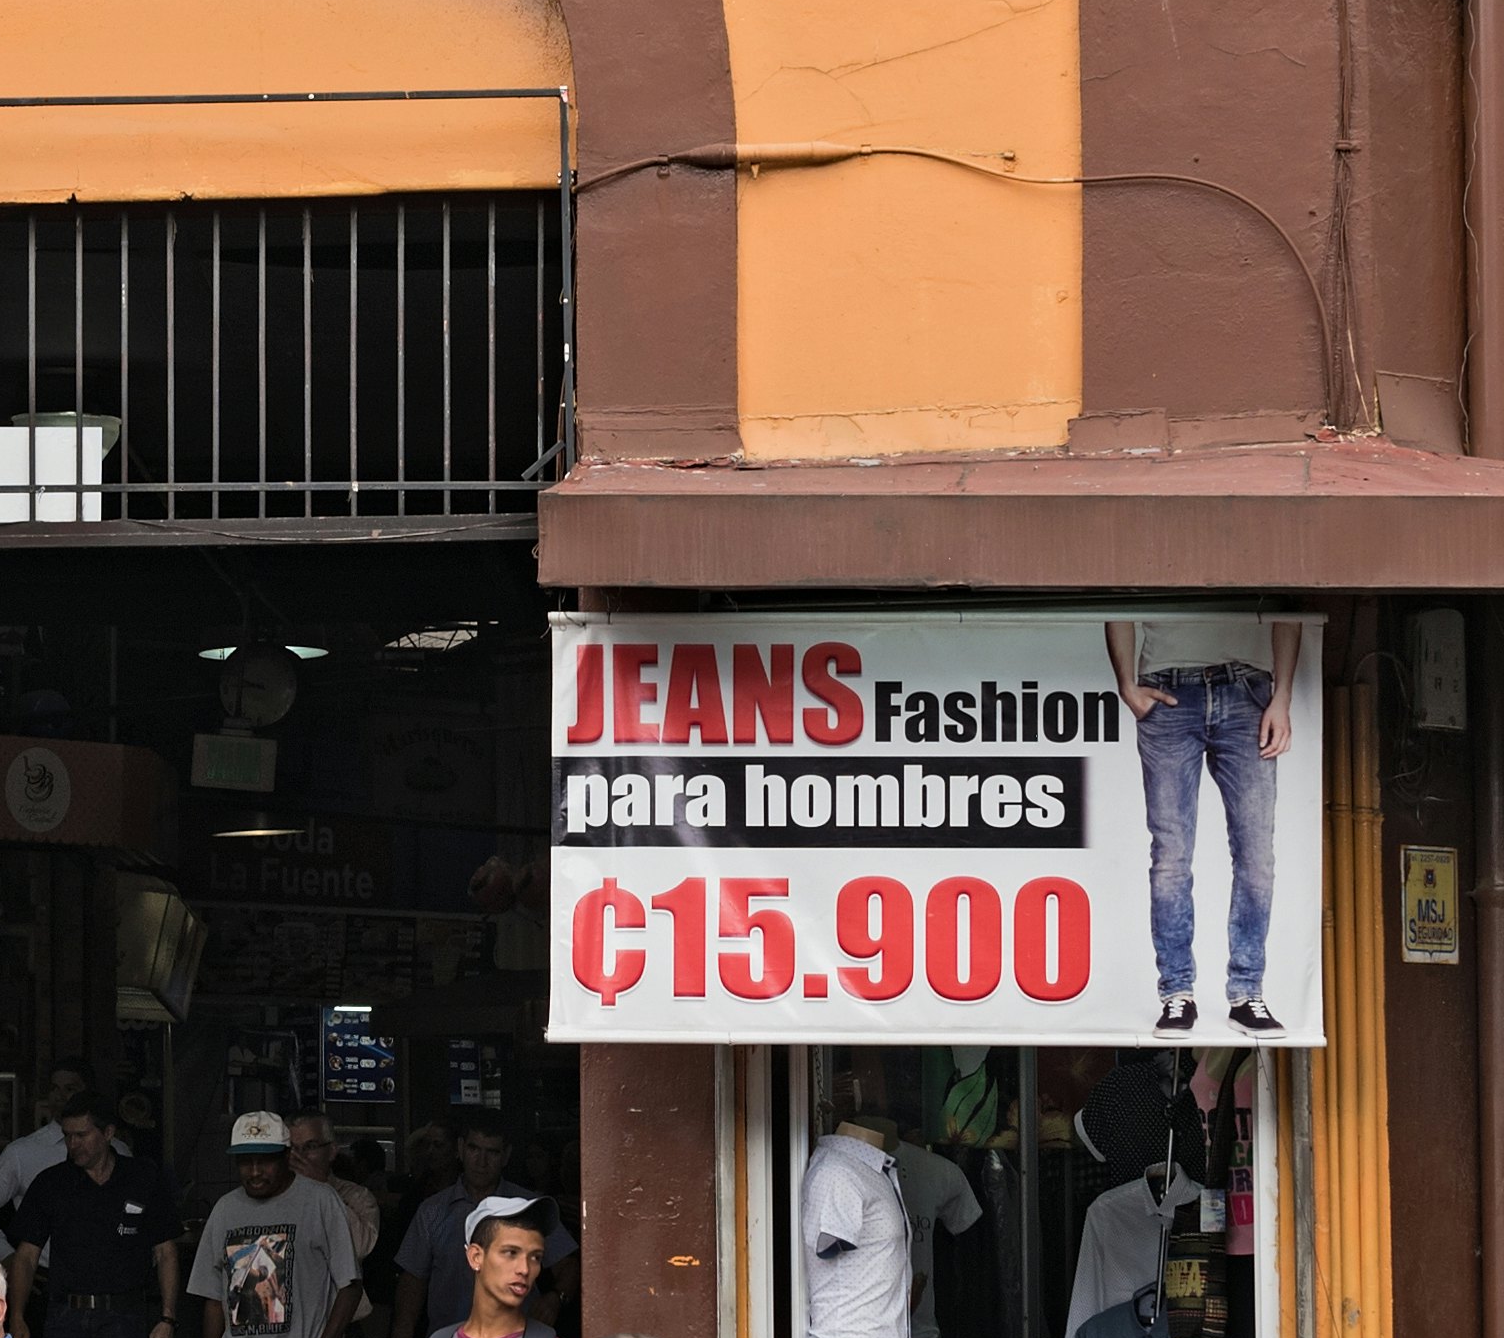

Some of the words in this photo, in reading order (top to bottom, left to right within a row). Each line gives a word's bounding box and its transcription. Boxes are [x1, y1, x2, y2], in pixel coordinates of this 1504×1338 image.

[567, 642, 864, 747] JEANS
[874, 680, 1120, 744] Fashion
[567, 770, 726, 833] para
[745, 764, 1066, 829] hombres
[260, 857, 376, 901] Fuente
[1409, 919, 1453, 943] SEGURIDAD
[1417, 899, 1445, 924] MSJ
